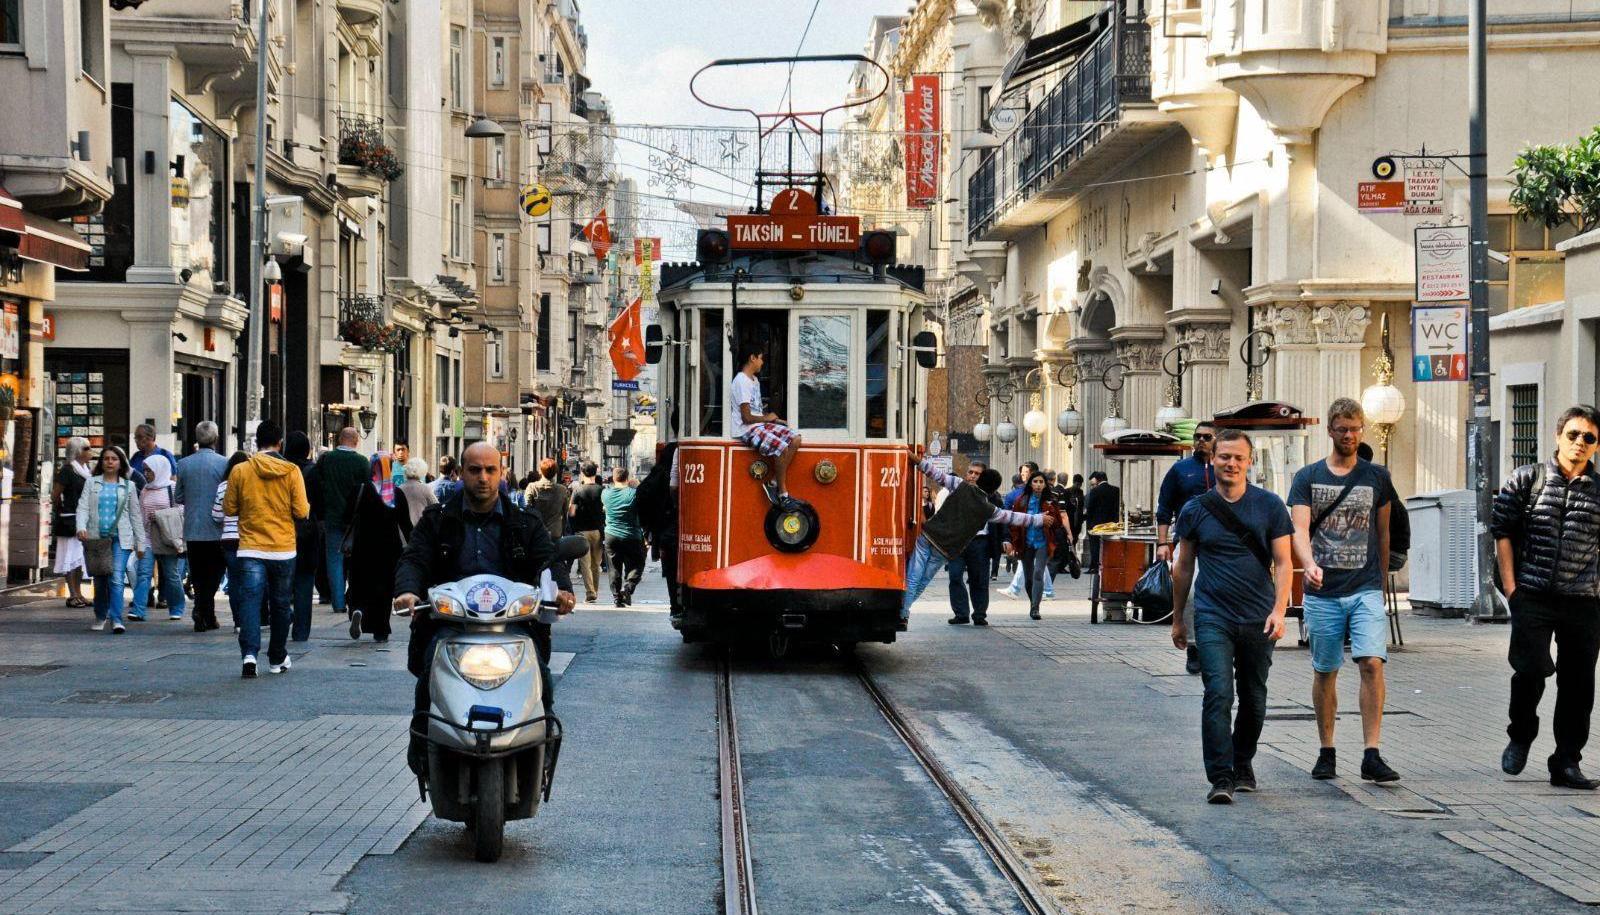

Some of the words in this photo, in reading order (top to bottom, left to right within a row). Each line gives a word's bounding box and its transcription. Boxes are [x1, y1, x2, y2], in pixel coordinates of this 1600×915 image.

[1359, 184, 1377, 192] ATIF
[1359, 192, 1387, 201] YILMAZ
[788, 190, 799, 210] 2
[1404, 205, 1420, 214] AĞA
[734, 221, 783, 242] TAKSİM
[808, 222, 854, 243] TÜNEL
[1421, 322, 1459, 340] WC
[684, 463, 705, 484] 223
[880, 466, 901, 488] 223
